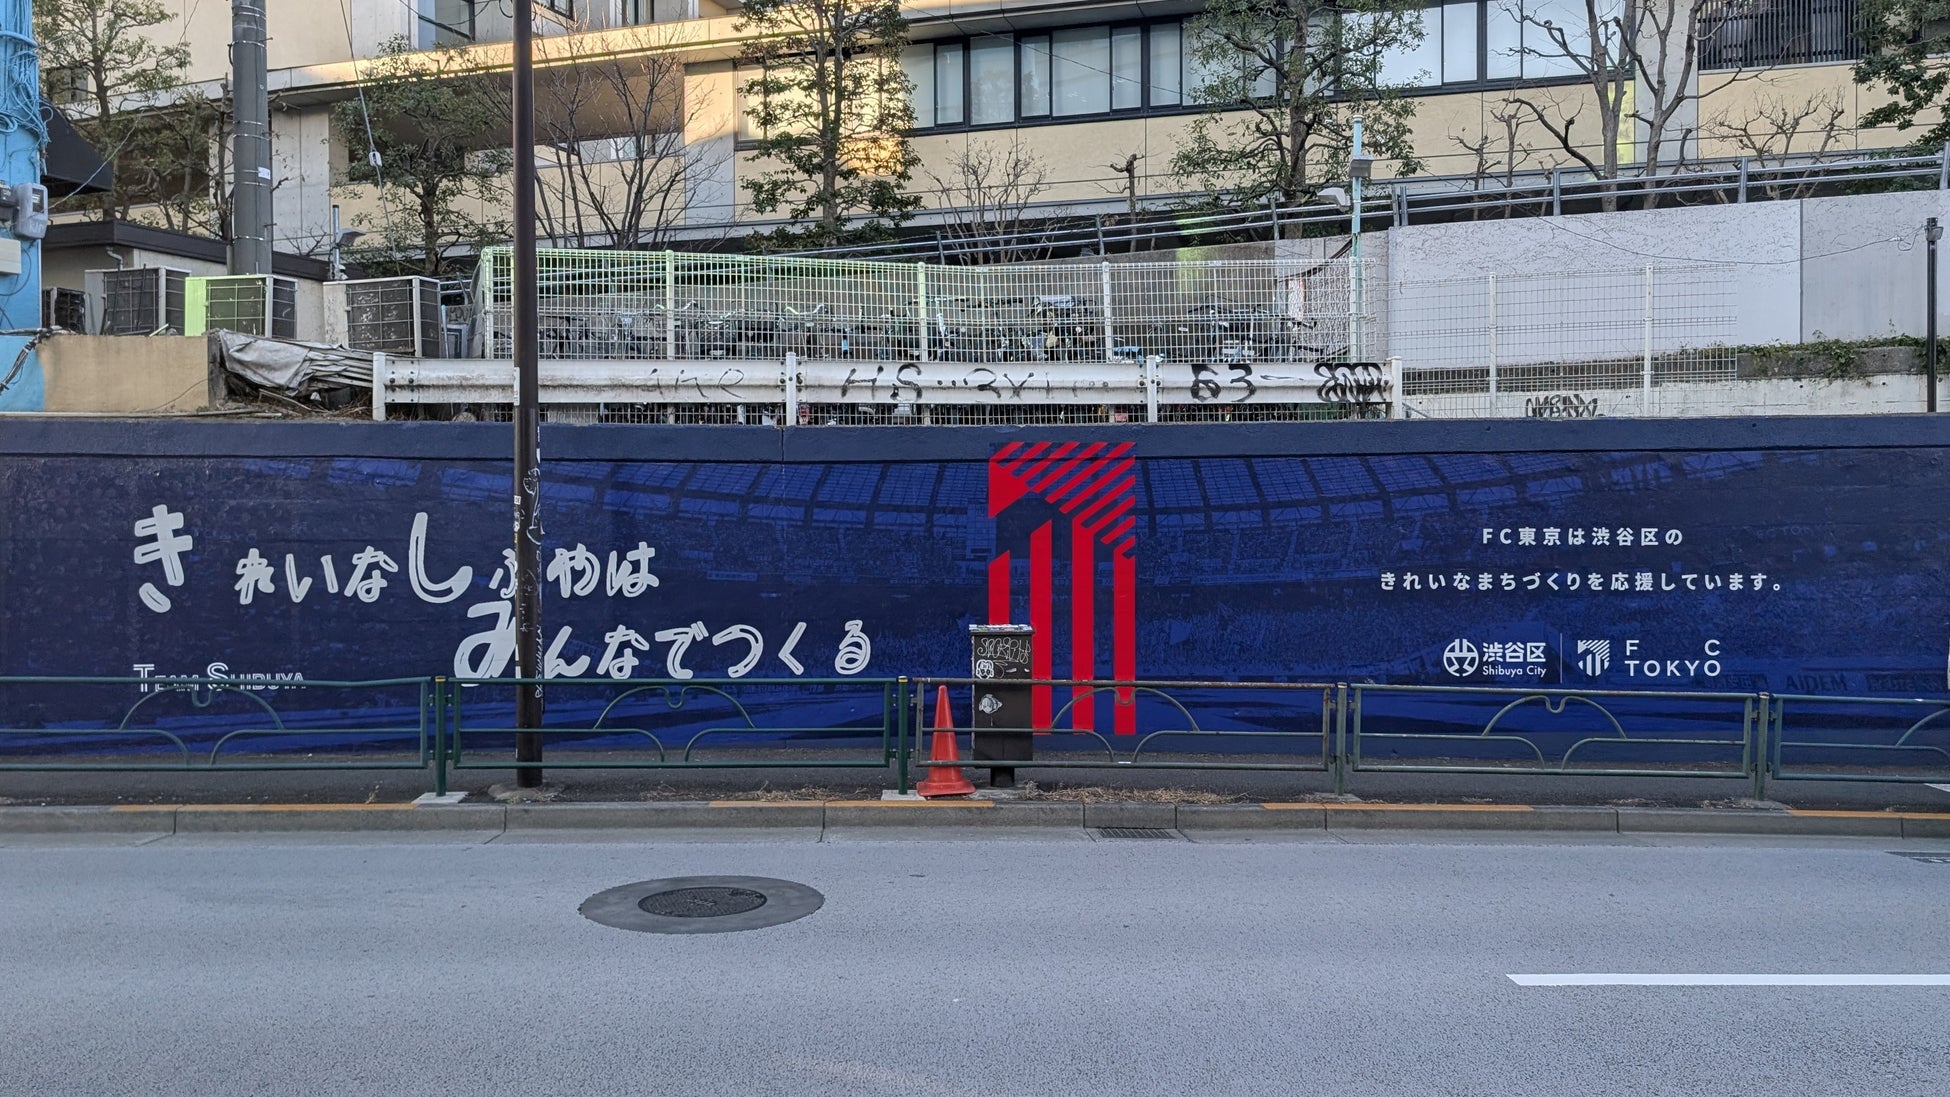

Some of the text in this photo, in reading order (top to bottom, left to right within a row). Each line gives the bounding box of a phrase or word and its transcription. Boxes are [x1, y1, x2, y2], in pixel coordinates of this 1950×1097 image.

[1482, 527, 1683, 546] FC東京は渋谷区の
[1380, 571, 1782, 591] きれいなまちづくりを応援しています。
[1482, 641, 1546, 662] 渋谷区
[1482, 664, 1547, 678] Shibuya City
[1625, 660, 1721, 677] TOKYO
